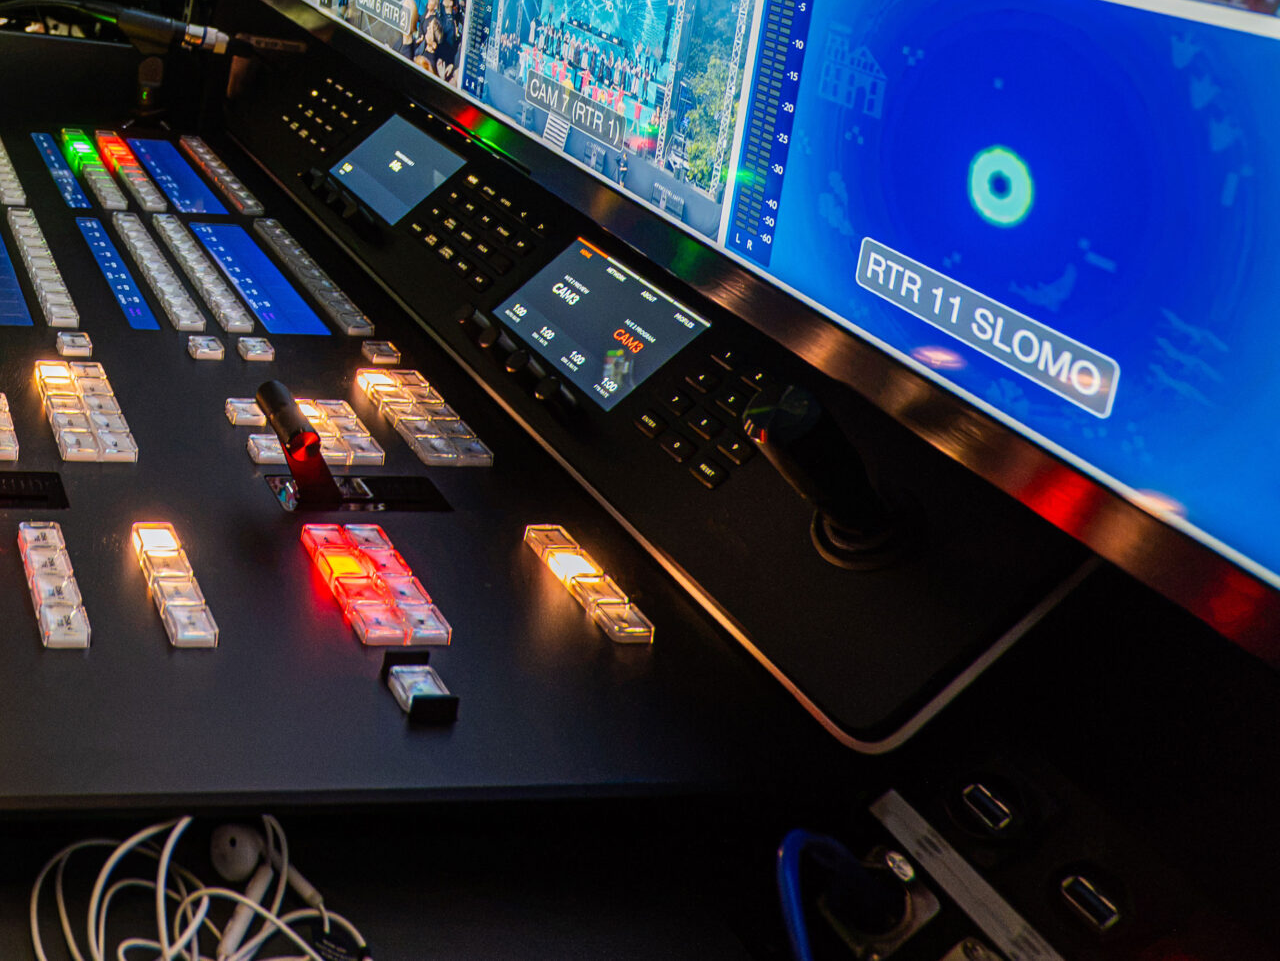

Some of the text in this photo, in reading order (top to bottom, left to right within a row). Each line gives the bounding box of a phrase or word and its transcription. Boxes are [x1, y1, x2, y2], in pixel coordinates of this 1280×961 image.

[798, 3, 806, 12] -5
[381, 1, 400, 24] (RTR
[400, 10, 408, 32] 2)
[792, 40, 804, 50] -10
[786, 71, 799, 81] -15
[529, 78, 620, 145] CAM 7 (RTR 1)
[781, 102, 794, 113] -20
[776, 134, 789, 144] -25
[771, 165, 784, 175] -30
[765, 199, 778, 210] -40
[762, 217, 775, 227] -50
[735, 233, 753, 251] L R
[760, 234, 772, 244] -60
[606, 266, 627, 283] NETWORK
[552, 282, 580, 306] CAM3
[640, 290, 658, 303] ABOUT
[513, 303, 528, 317] 1:00
[673, 312, 695, 329] PROFILES
[866, 251, 1102, 396] RTR 11 SLOMO
[540, 326, 555, 340] 1:00
[613, 328, 645, 354] CAM3
[569, 350, 586, 365] 1:00
[601, 377, 618, 392] 1:00
